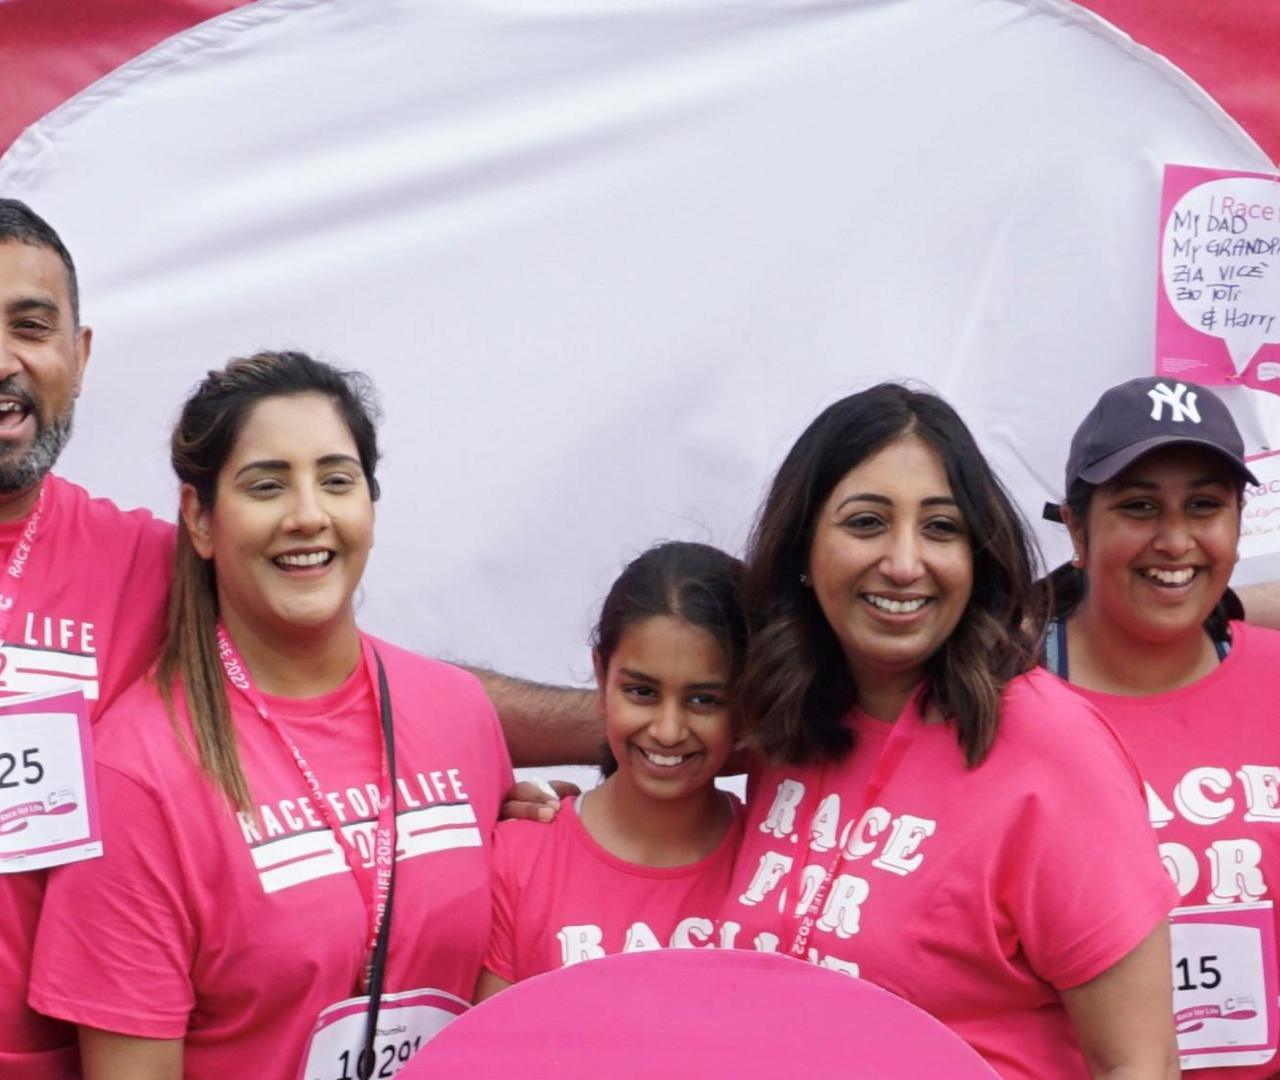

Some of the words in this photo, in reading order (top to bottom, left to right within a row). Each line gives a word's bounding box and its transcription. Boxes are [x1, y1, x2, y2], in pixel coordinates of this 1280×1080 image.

[1206, 214, 1249, 235] DAD
[1221, 196, 1275, 220] Race
[1224, 308, 1277, 334] Harry
[8, 539, 31, 579] RACE
[23, 611, 97, 654] LIFE
[223, 657, 250, 691] 2022
[236, 796, 324, 844] RACE
[327, 782, 382, 823] FOR
[396, 768, 469, 807] LIFE
[377, 828, 392, 865] 2022
[759, 778, 936, 877] RACE
[376, 868, 392, 900] LIFE
[739, 851, 870, 938] FOR
[791, 916, 815, 955] 2022
[1173, 954, 1222, 992] 15
